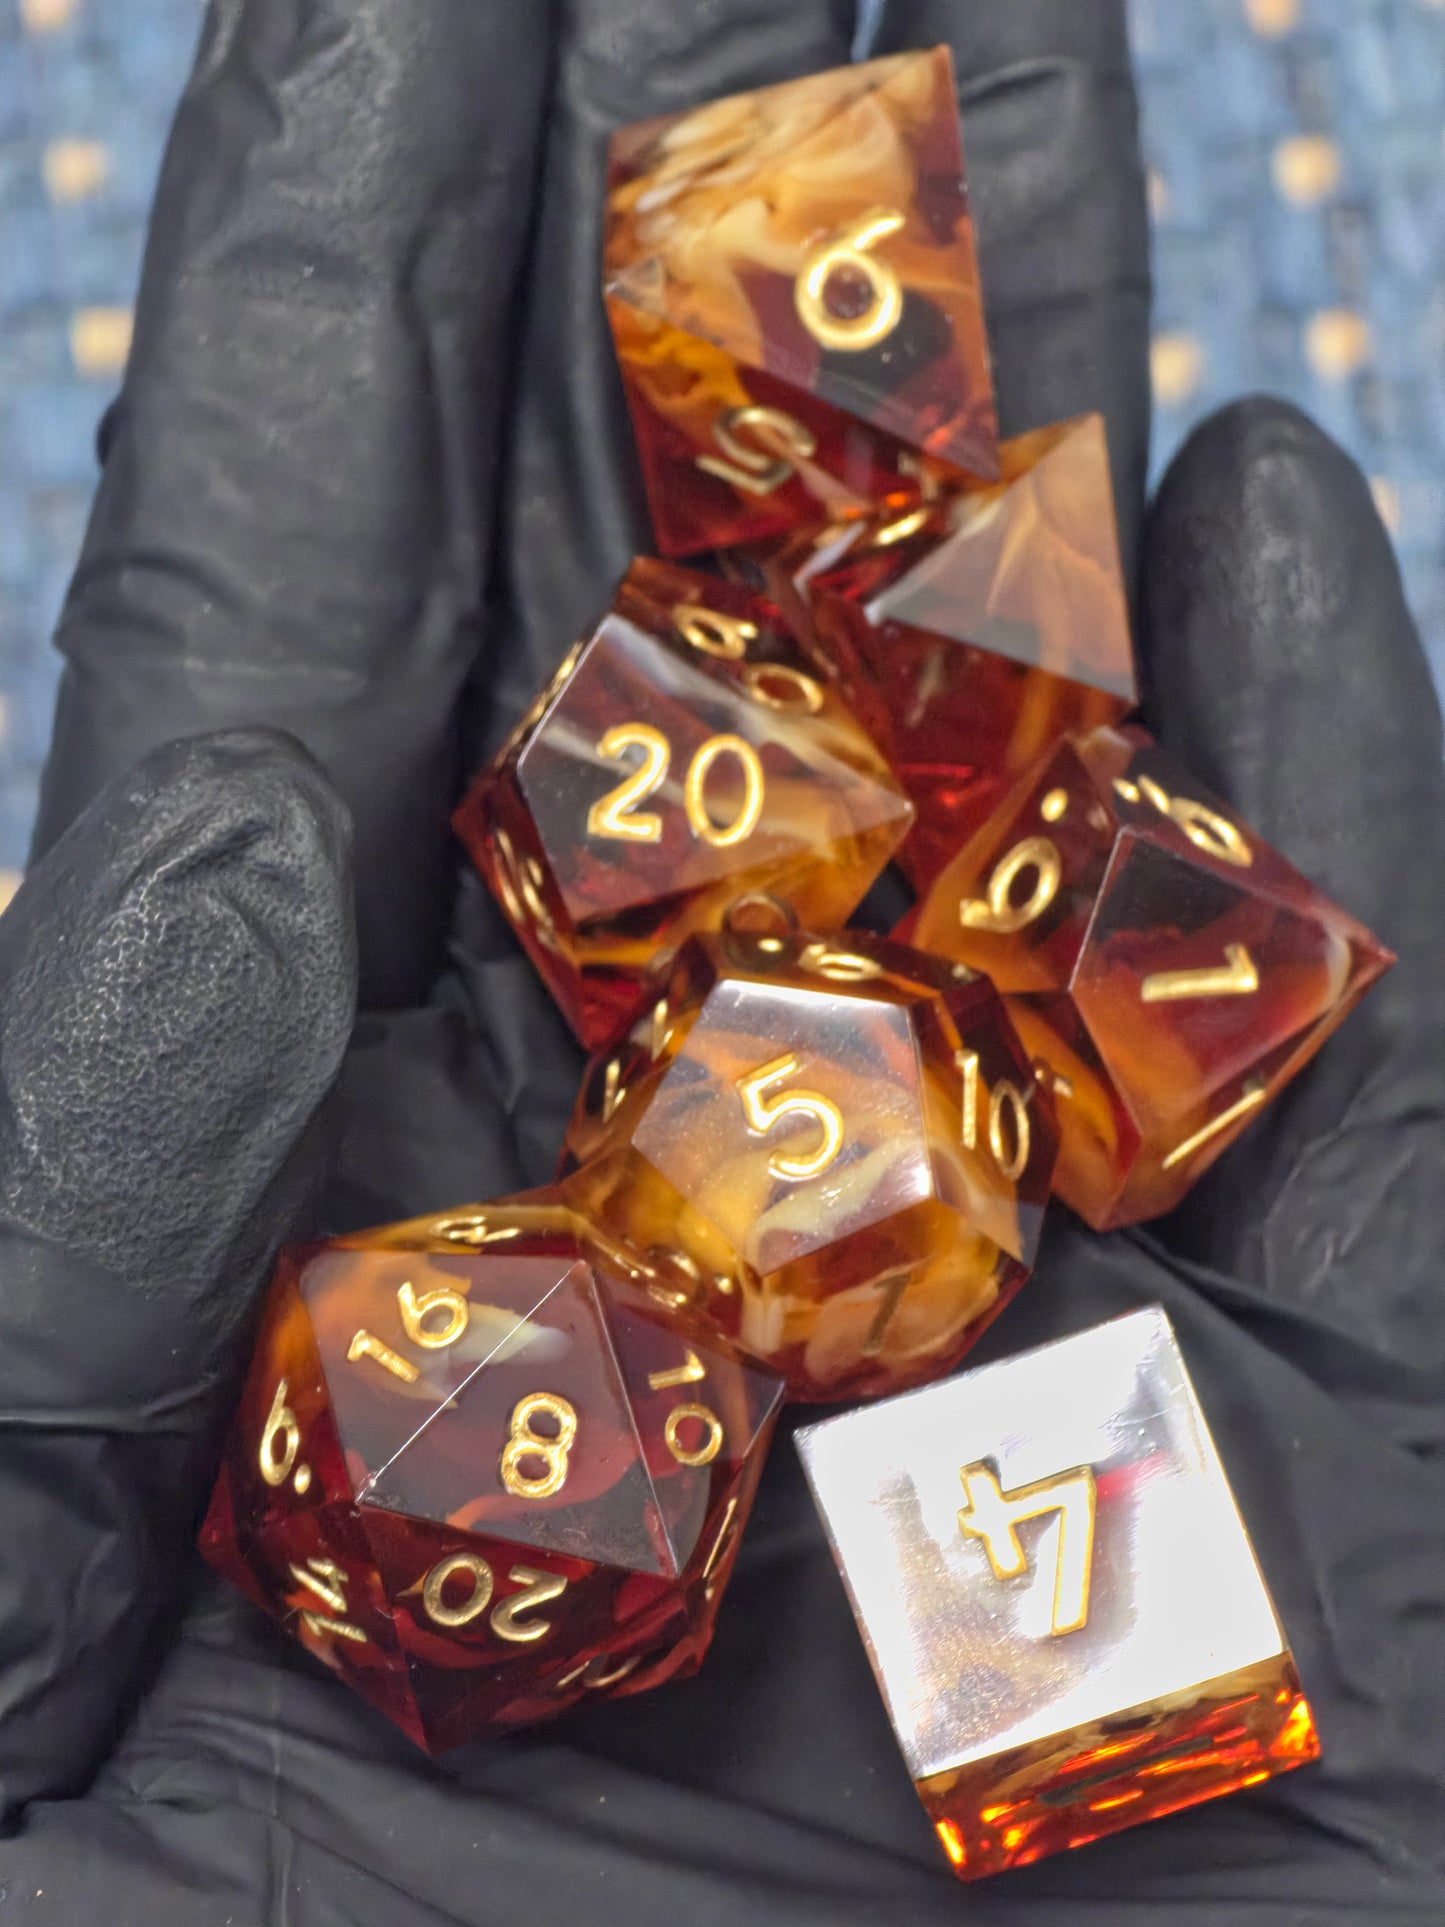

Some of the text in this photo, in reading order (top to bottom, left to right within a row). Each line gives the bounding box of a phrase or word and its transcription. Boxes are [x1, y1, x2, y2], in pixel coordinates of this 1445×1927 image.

[796, 211, 906, 351] 6
[696, 405, 817, 496] 5
[587, 722, 765, 847] 20
[1141, 944, 1258, 1002] 1
[735, 1052, 844, 1182] 5
[954, 1047, 1030, 1181] 10
[347, 1281, 468, 1383] 16
[501, 1392, 577, 1498] 8
[648, 1350, 723, 1466] 10
[423, 1552, 568, 1642] 20
[957, 1454, 1099, 1637] 4
